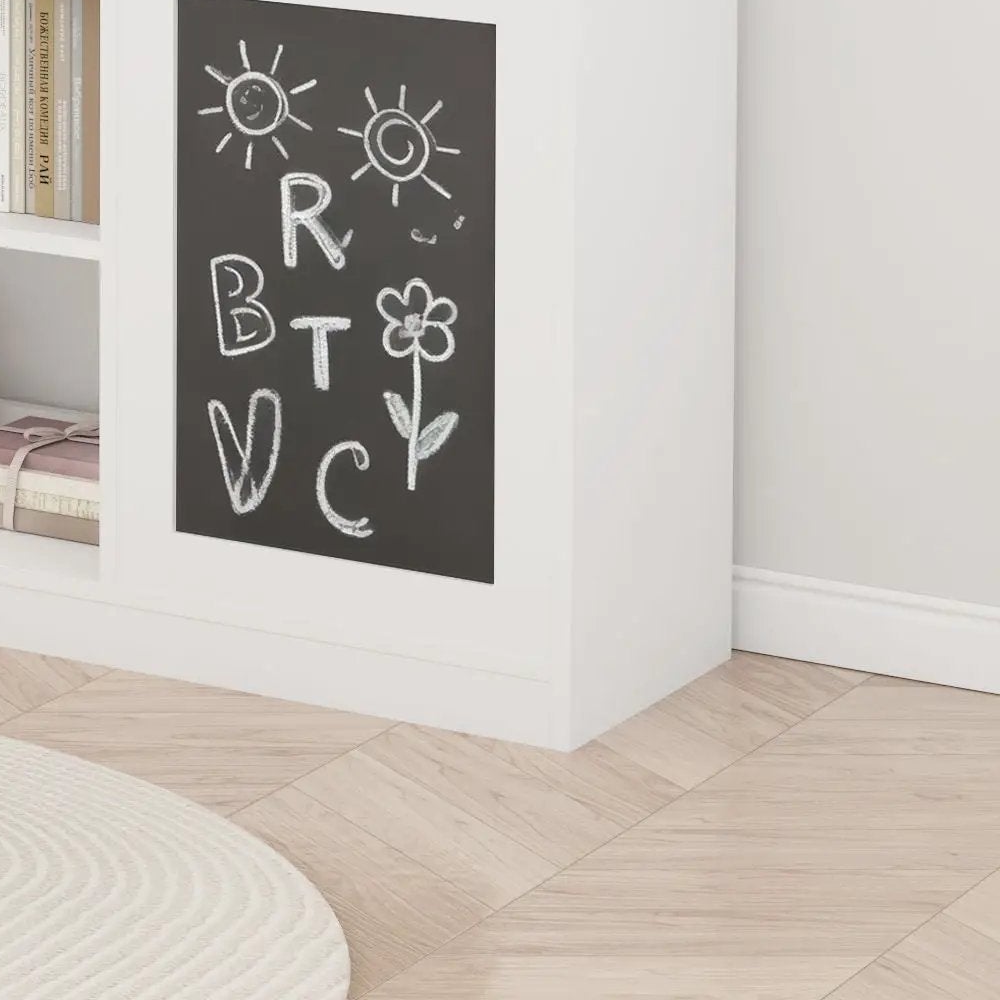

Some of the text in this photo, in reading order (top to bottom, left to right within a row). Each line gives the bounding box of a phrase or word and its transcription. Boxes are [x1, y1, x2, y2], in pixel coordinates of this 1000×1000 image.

[39, 11, 52, 185] БОЖЕСТВЕННАЯ КОМЕДИЯ РАЙ
[279, 171, 353, 270] R
[210, 252, 276, 357] B
[289, 315, 352, 391] T
[207, 388, 281, 515] V
[316, 440, 373, 538] C
